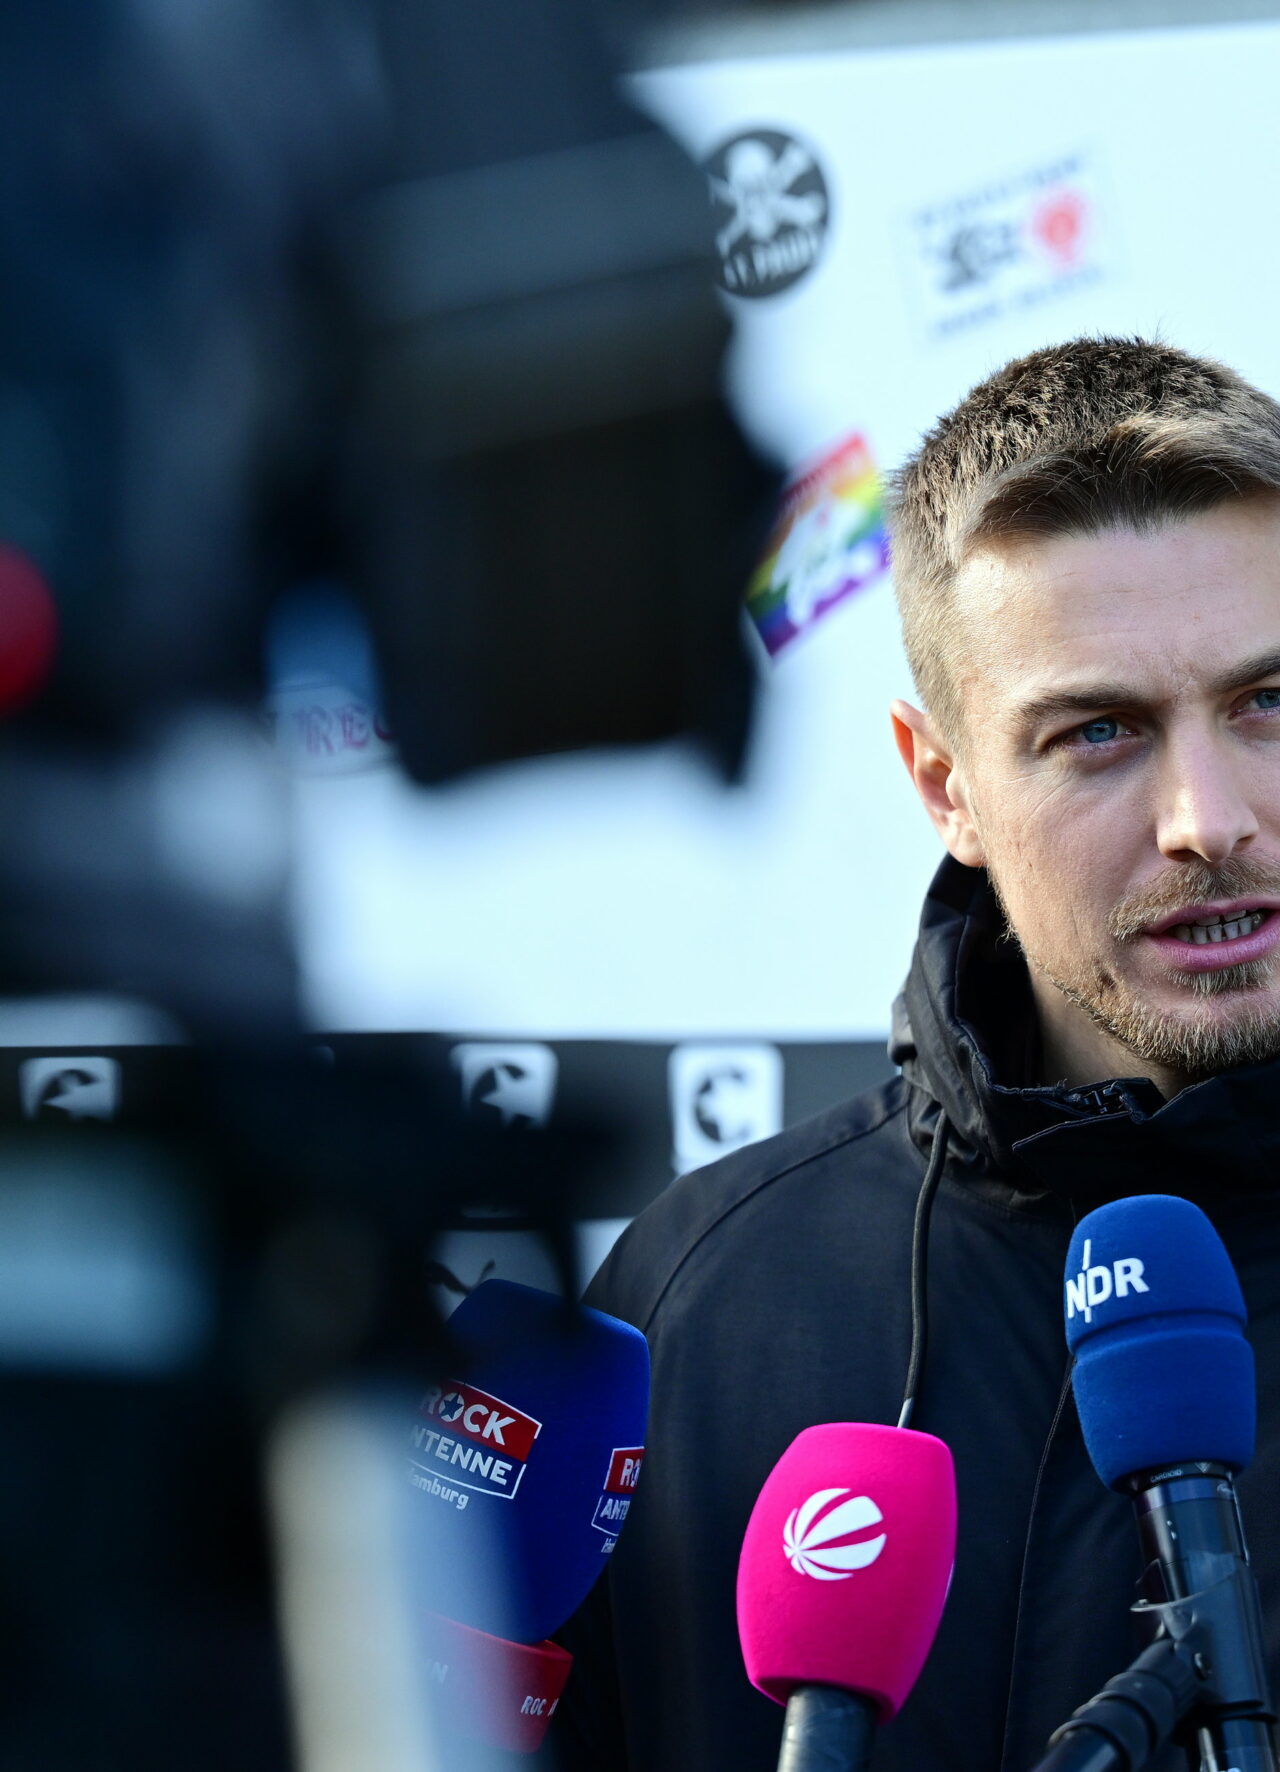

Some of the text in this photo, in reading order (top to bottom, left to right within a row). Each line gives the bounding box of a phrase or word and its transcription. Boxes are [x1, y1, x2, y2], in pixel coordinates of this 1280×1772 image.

[1066, 1254, 1149, 1320] NDR
[420, 1386, 516, 1446] ROCK
[410, 1425, 512, 1485] NTENNE
